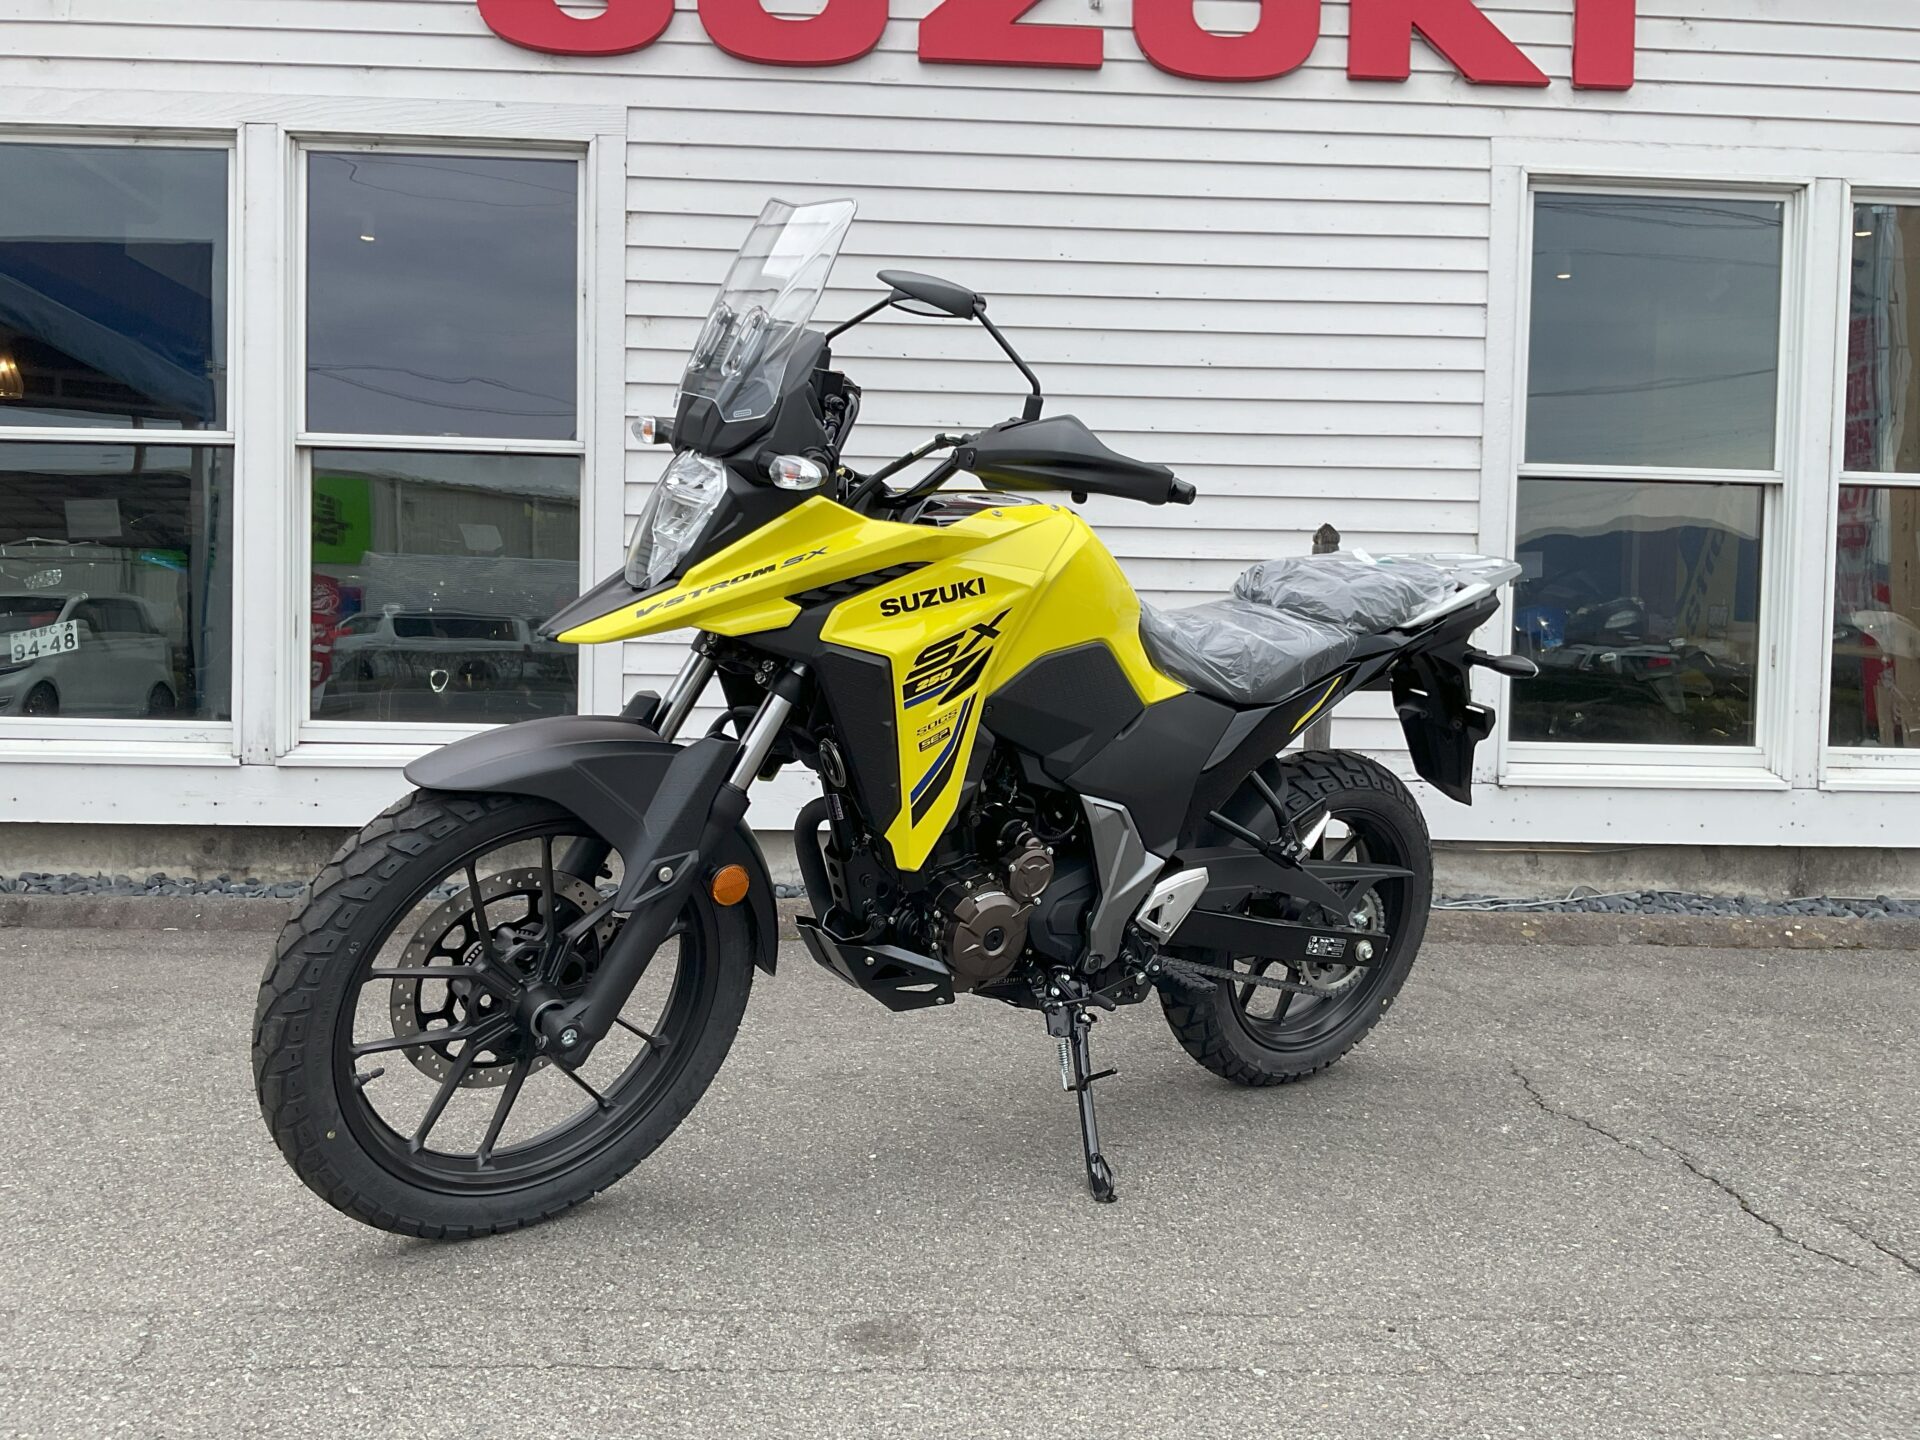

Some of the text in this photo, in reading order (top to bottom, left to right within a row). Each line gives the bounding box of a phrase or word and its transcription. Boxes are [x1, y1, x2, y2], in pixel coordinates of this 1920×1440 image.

[636, 546, 828, 618] V-STROM SX
[880, 577, 985, 617] SUZUKI
[13, 632, 76, 660] 94-48
[905, 607, 1013, 682] SX
[915, 668, 953, 692] 250
[920, 728, 949, 748] SEP
